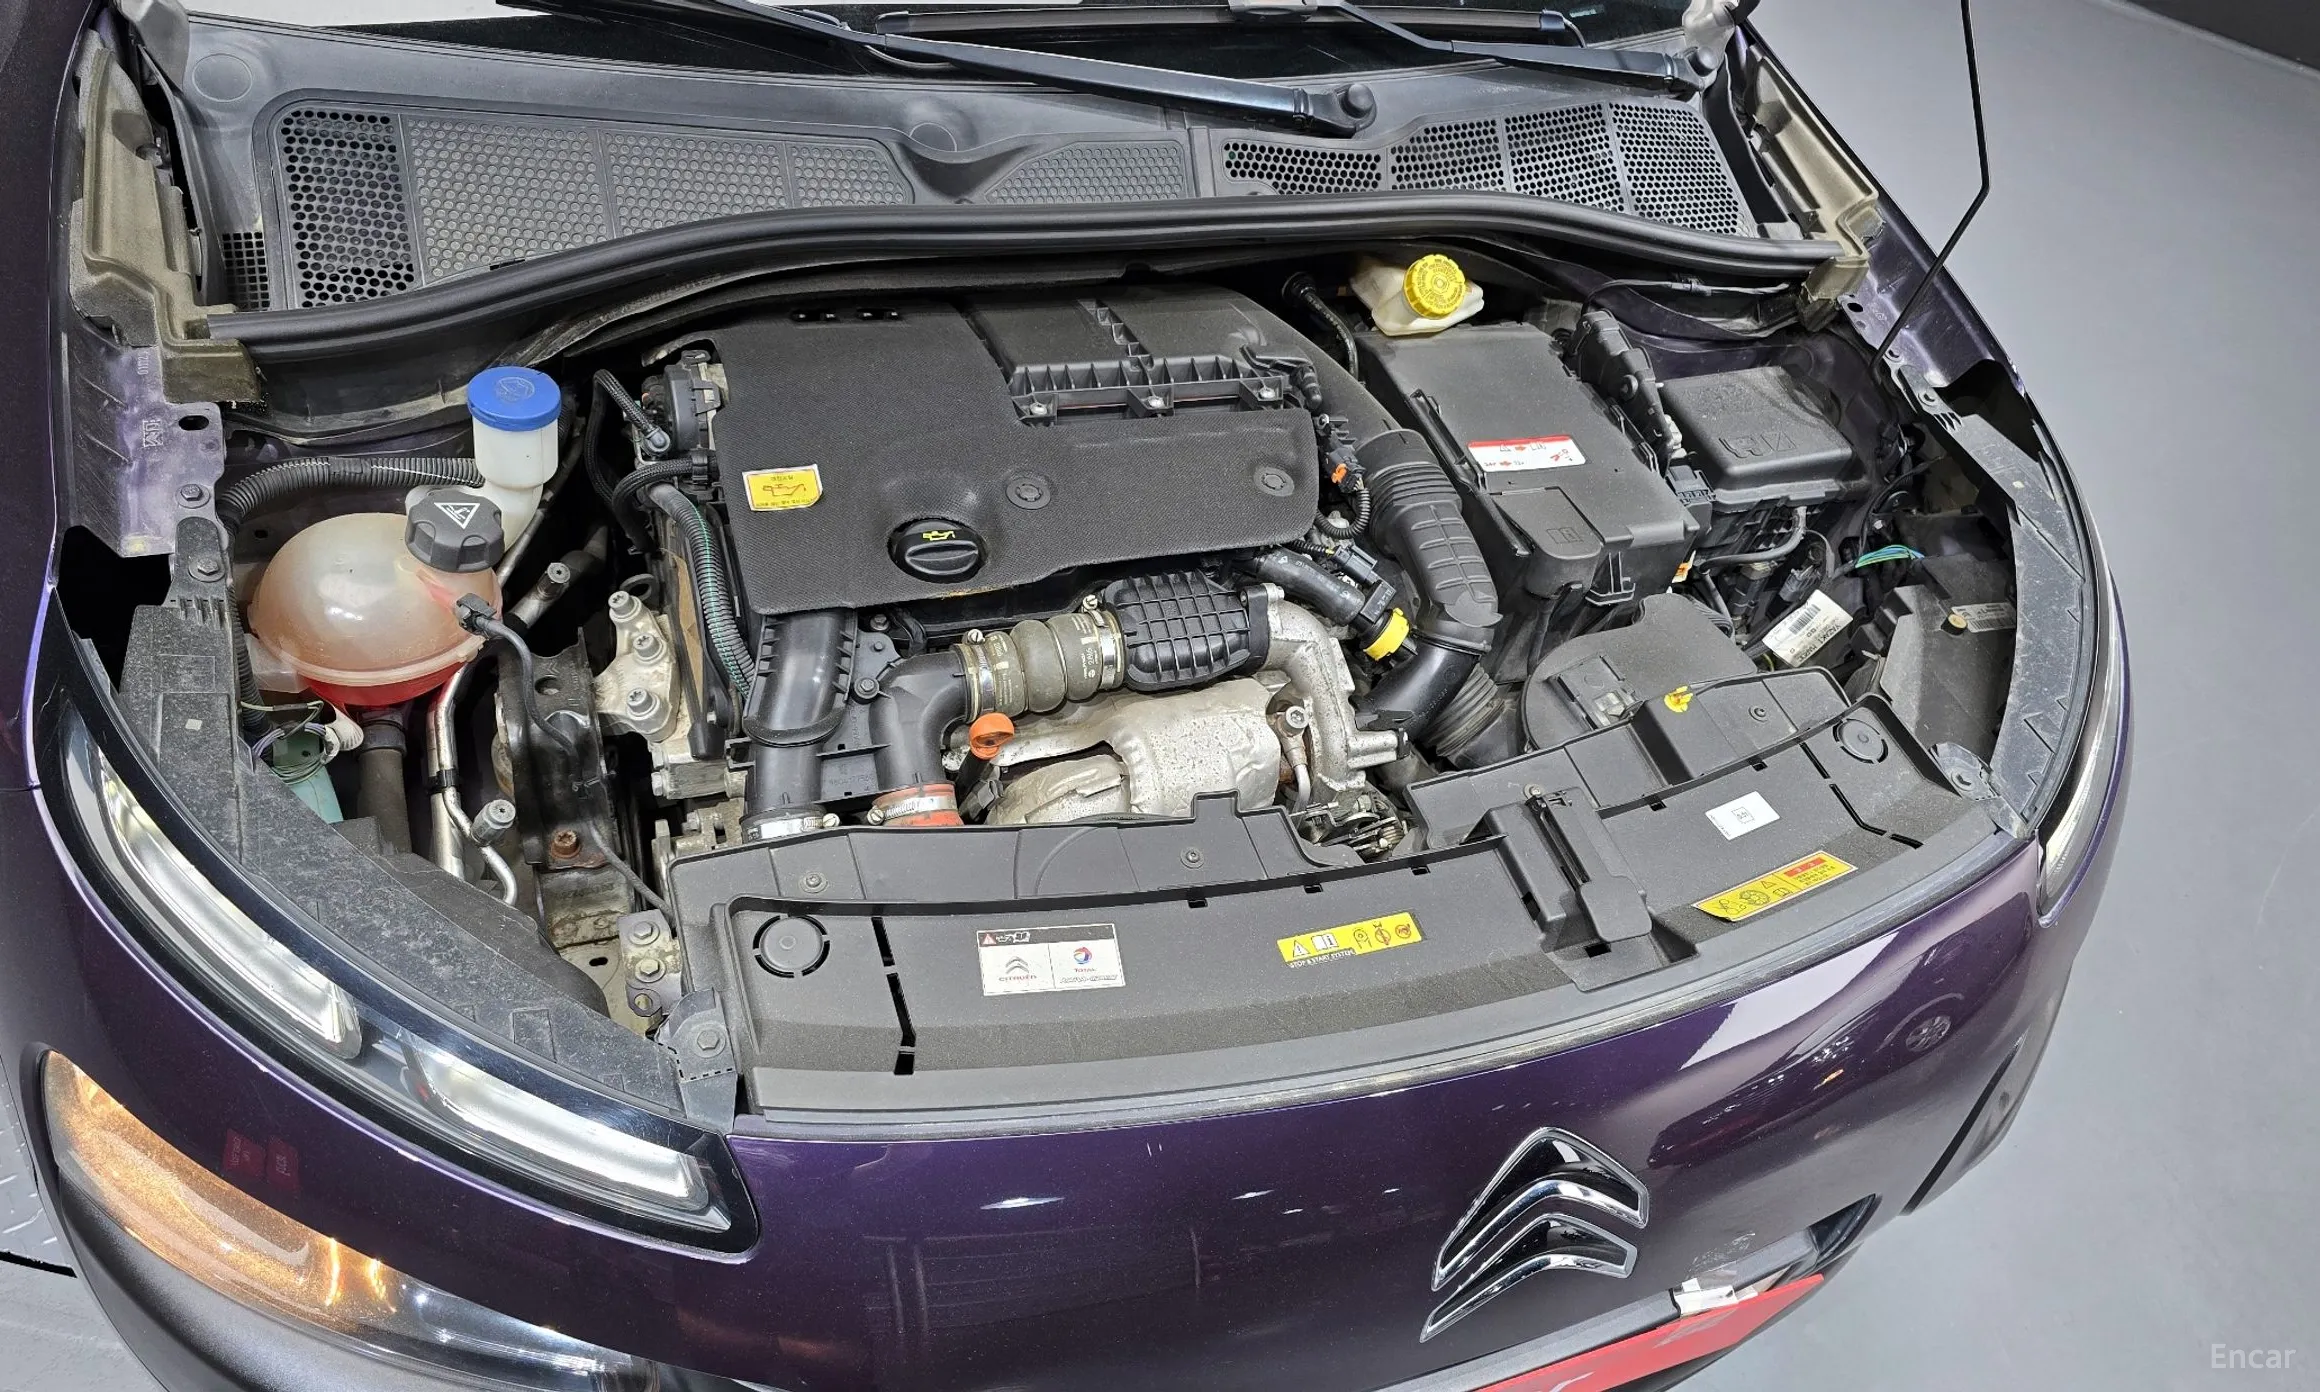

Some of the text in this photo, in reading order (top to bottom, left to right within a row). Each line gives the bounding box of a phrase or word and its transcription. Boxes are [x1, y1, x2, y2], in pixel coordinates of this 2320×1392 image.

[1288, 959, 1306, 969] STOP
[1312, 954, 1331, 964] START
[1331, 950, 1356, 959] SYSTEM
